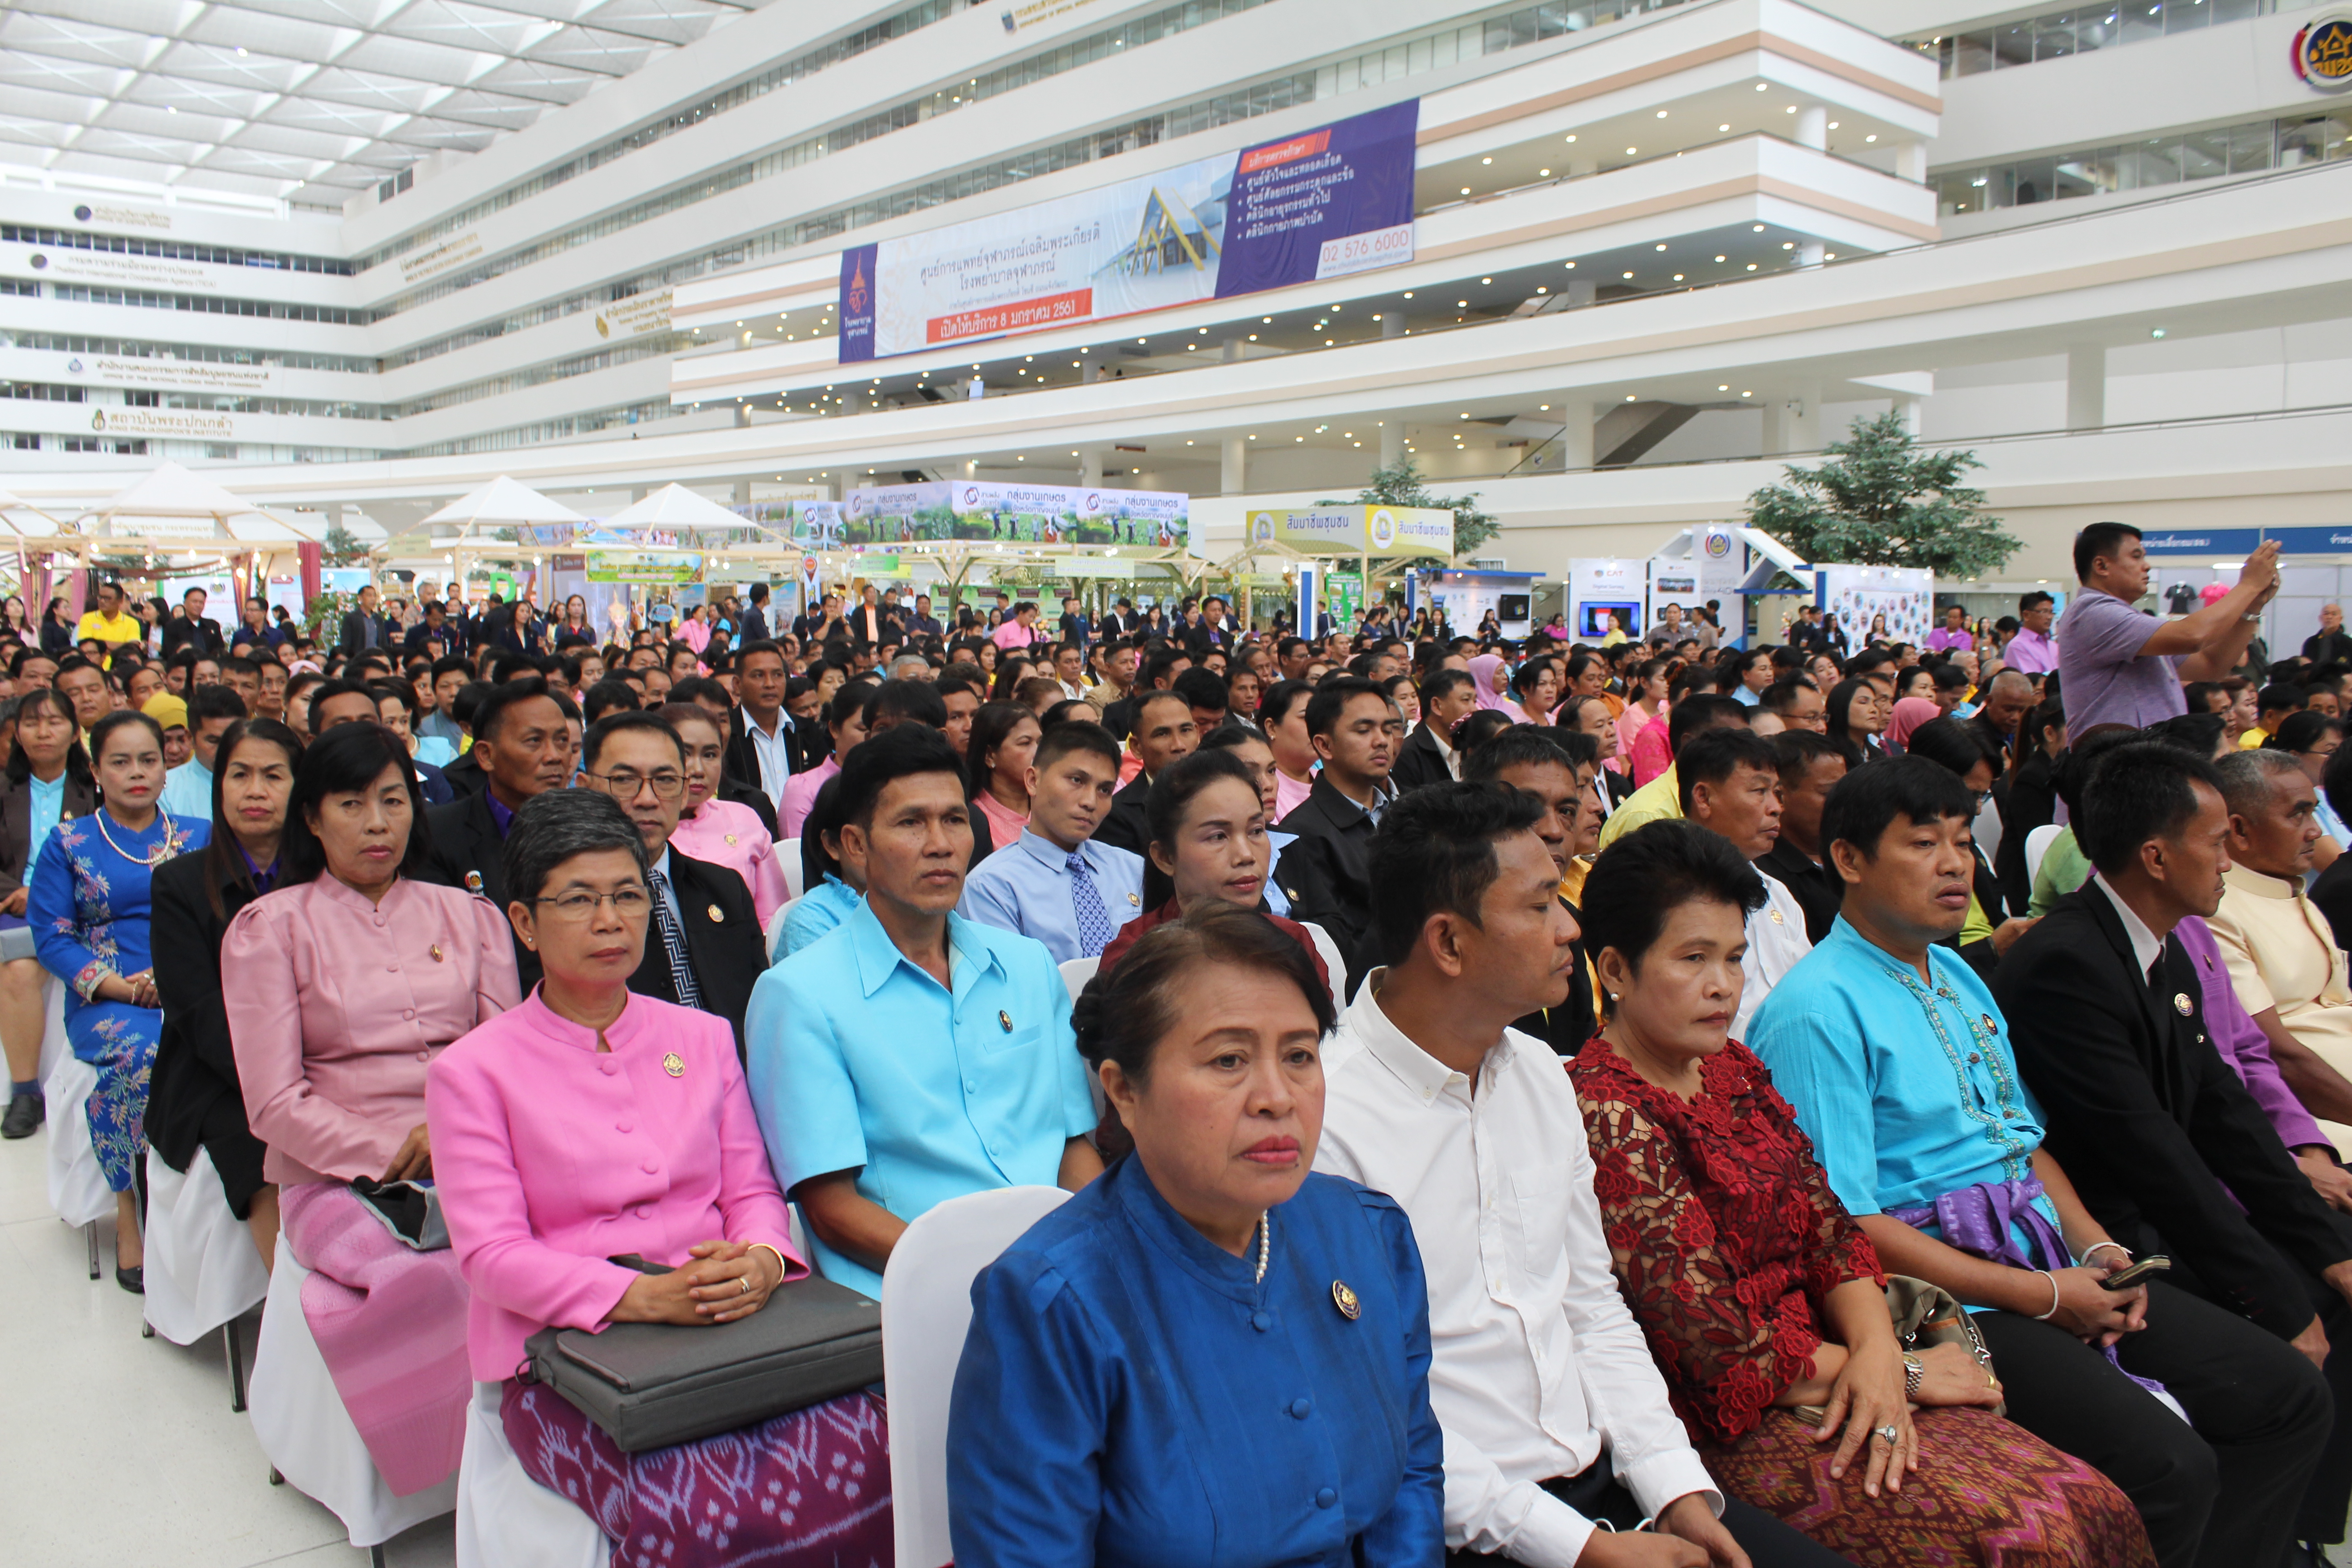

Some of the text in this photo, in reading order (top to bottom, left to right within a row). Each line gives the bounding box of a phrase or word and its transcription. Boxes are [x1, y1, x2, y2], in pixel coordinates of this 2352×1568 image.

[920, 221, 1100, 287] ศูนย์การแพทย์จุฬาภรณ์เฉลิมพระเกียรติ
[1323, 230, 1409, 262] 02 576 6000
[960, 252, 1056, 291] โรงพยาบาลจุฬาภรณ์
[940, 299, 1075, 338] เปิดให้บริการ 8 มกราคม 2561
[110, 410, 233, 429] สถาบันพระปกเกล้า
[878, 492, 917, 505] กลุ่มงานเกษตร
[1007, 488, 1066, 503] กลุ่มงานเกษตร
[1125, 495, 1178, 509] กลุ่มงานเกษตร
[1012, 505, 1061, 516] จังหวัดกาญจนบุรี
[1129, 510, 1173, 520] จังหวัดกาญจนบุรี
[1287, 512, 1349, 533] สัมมาชีพชุมชน
[1398, 519, 1450, 539] สัมมาชีพชุมชน
